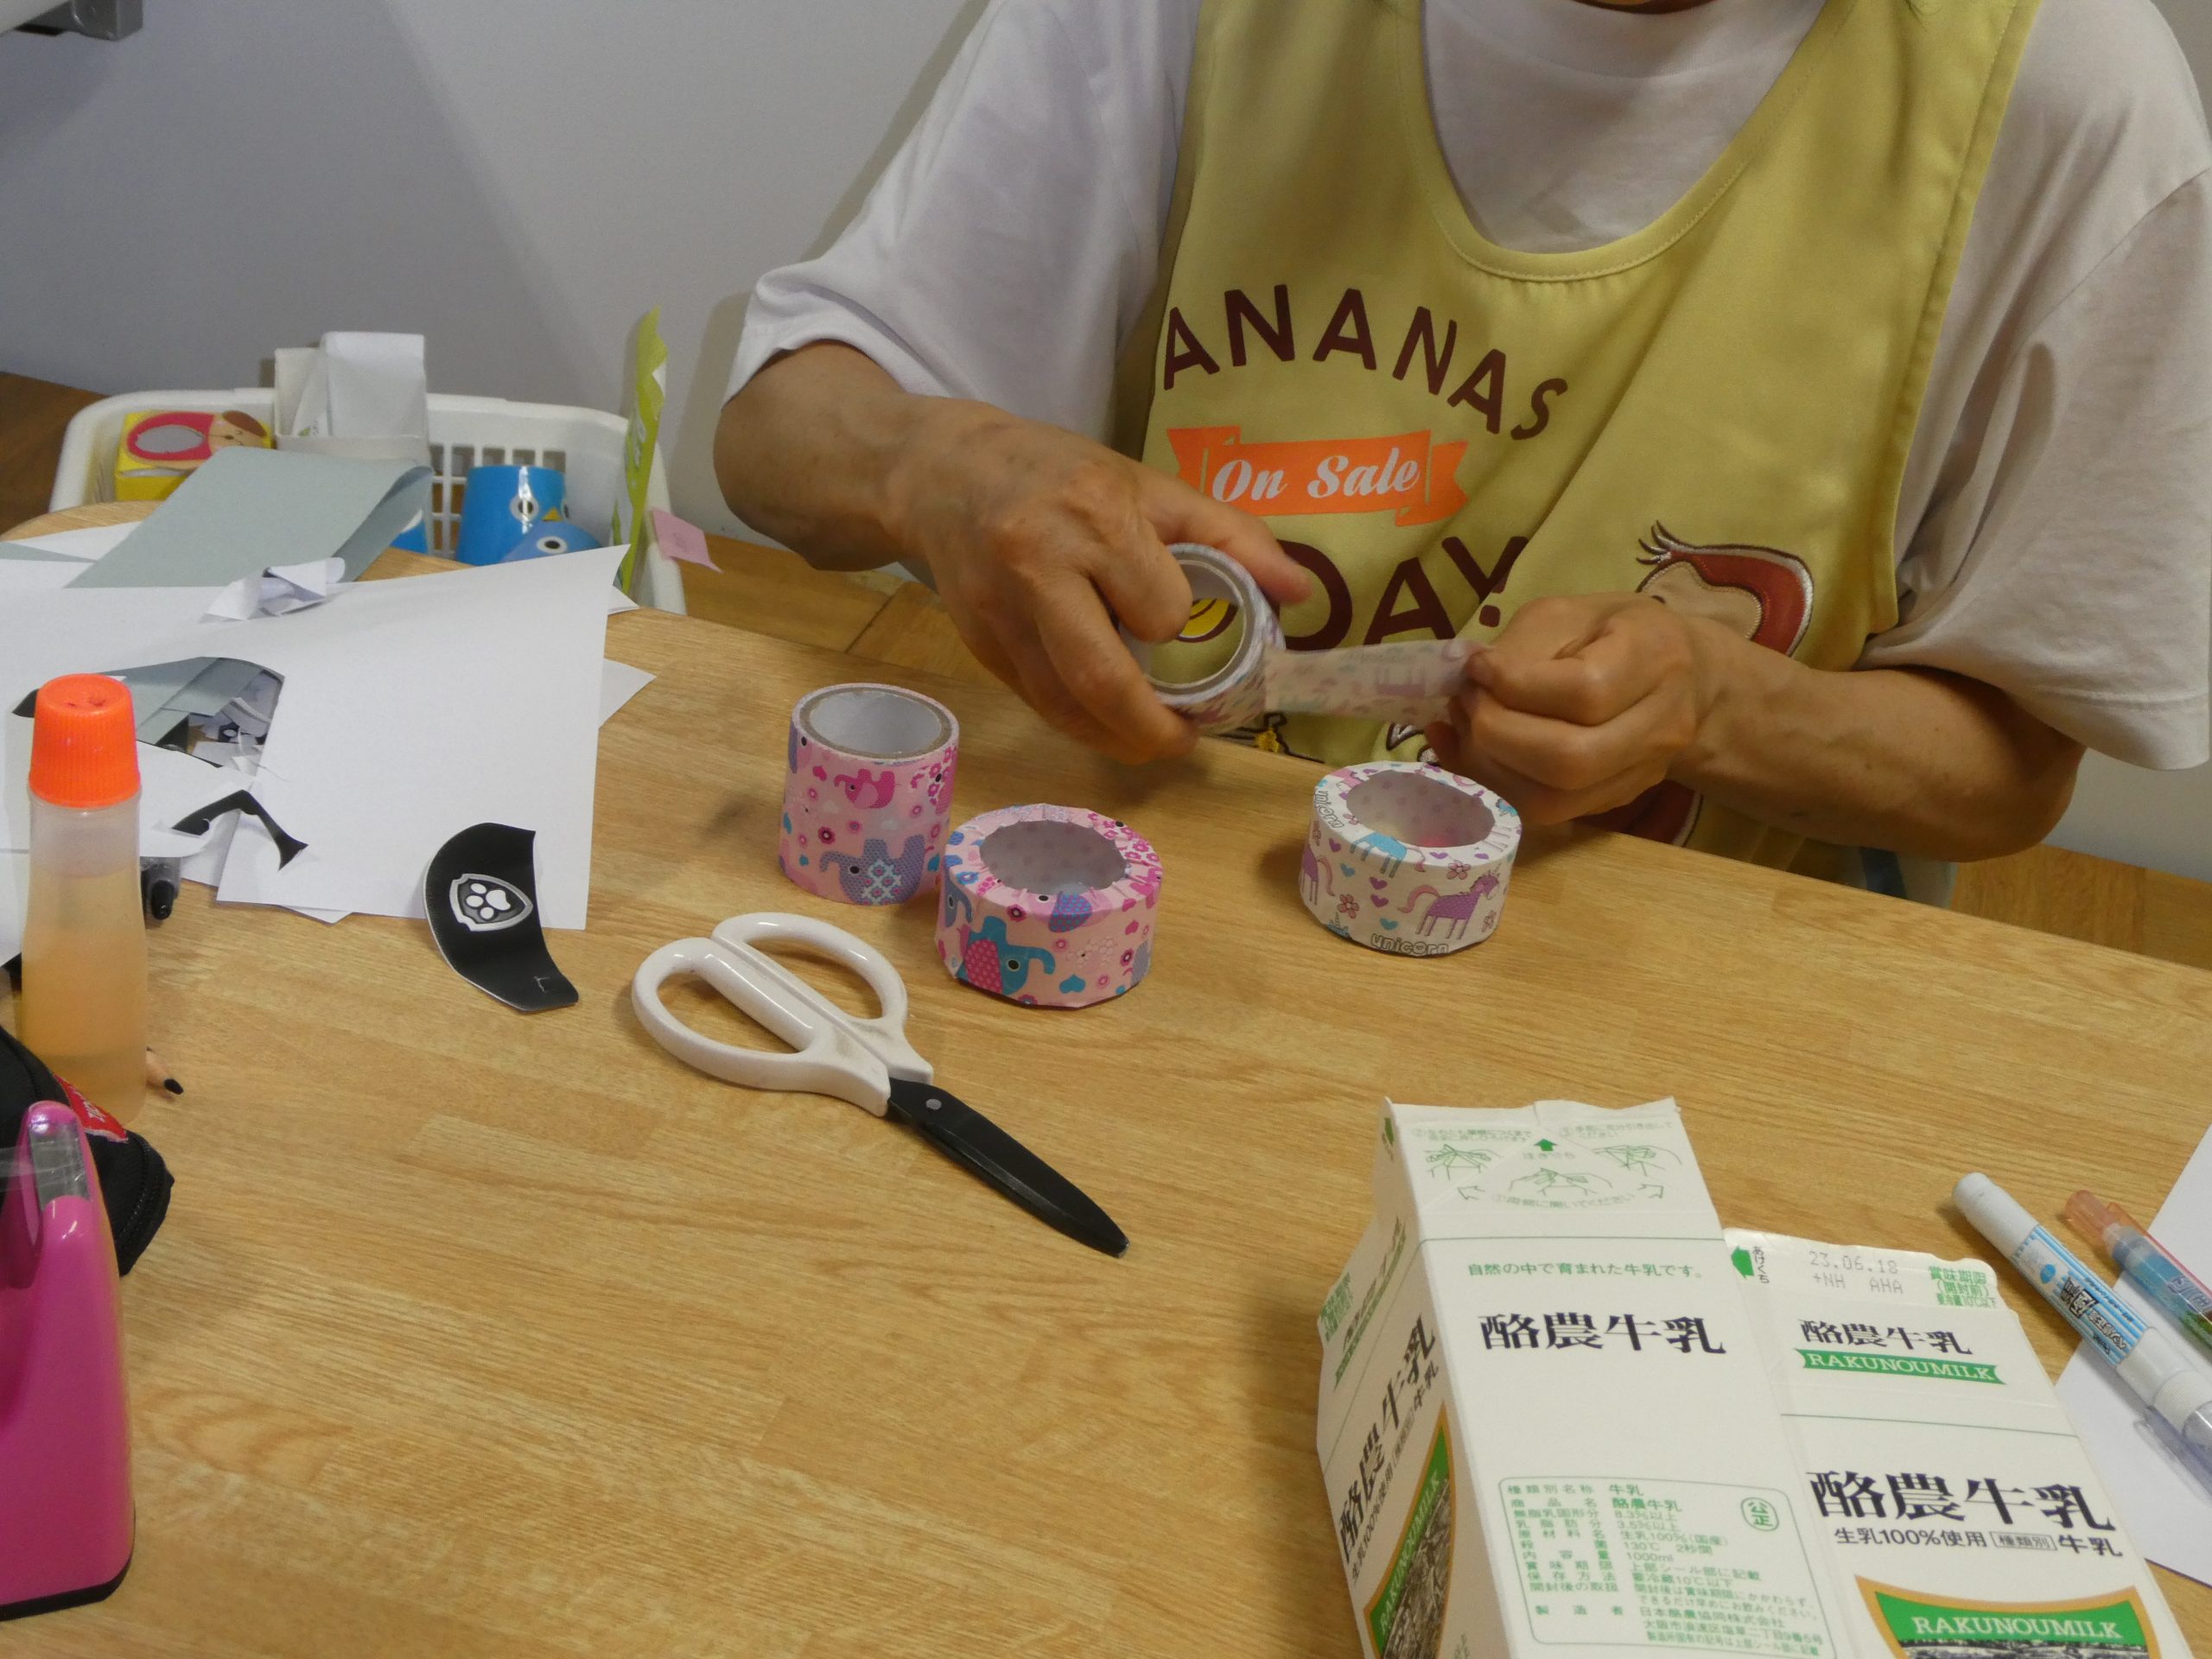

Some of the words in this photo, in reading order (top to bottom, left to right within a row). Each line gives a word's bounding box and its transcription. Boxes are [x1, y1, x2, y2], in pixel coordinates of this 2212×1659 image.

[1212, 458, 1288, 503] On
[1307, 447, 1419, 499] Sale
[1370, 933, 1450, 955] unicorn
[1809, 1250, 1899, 1274] 23.06.18
[1869, 1278, 1904, 1294] AHA
[1479, 1312, 1727, 1356] 酪農牛乳
[1797, 1319, 1974, 1355] 酪農牛乳
[1807, 1352, 1997, 1381] RAKUNOUMILK
[1609, 1484, 1644, 1497] 牛乳
[1806, 1470, 2117, 1532] 酪農牛乳
[1834, 1527, 1987, 1548] 生乳100%使用
[2057, 1535, 2123, 1557] 牛乳
[1912, 1616, 2123, 1639] RAKUNOUMILK
